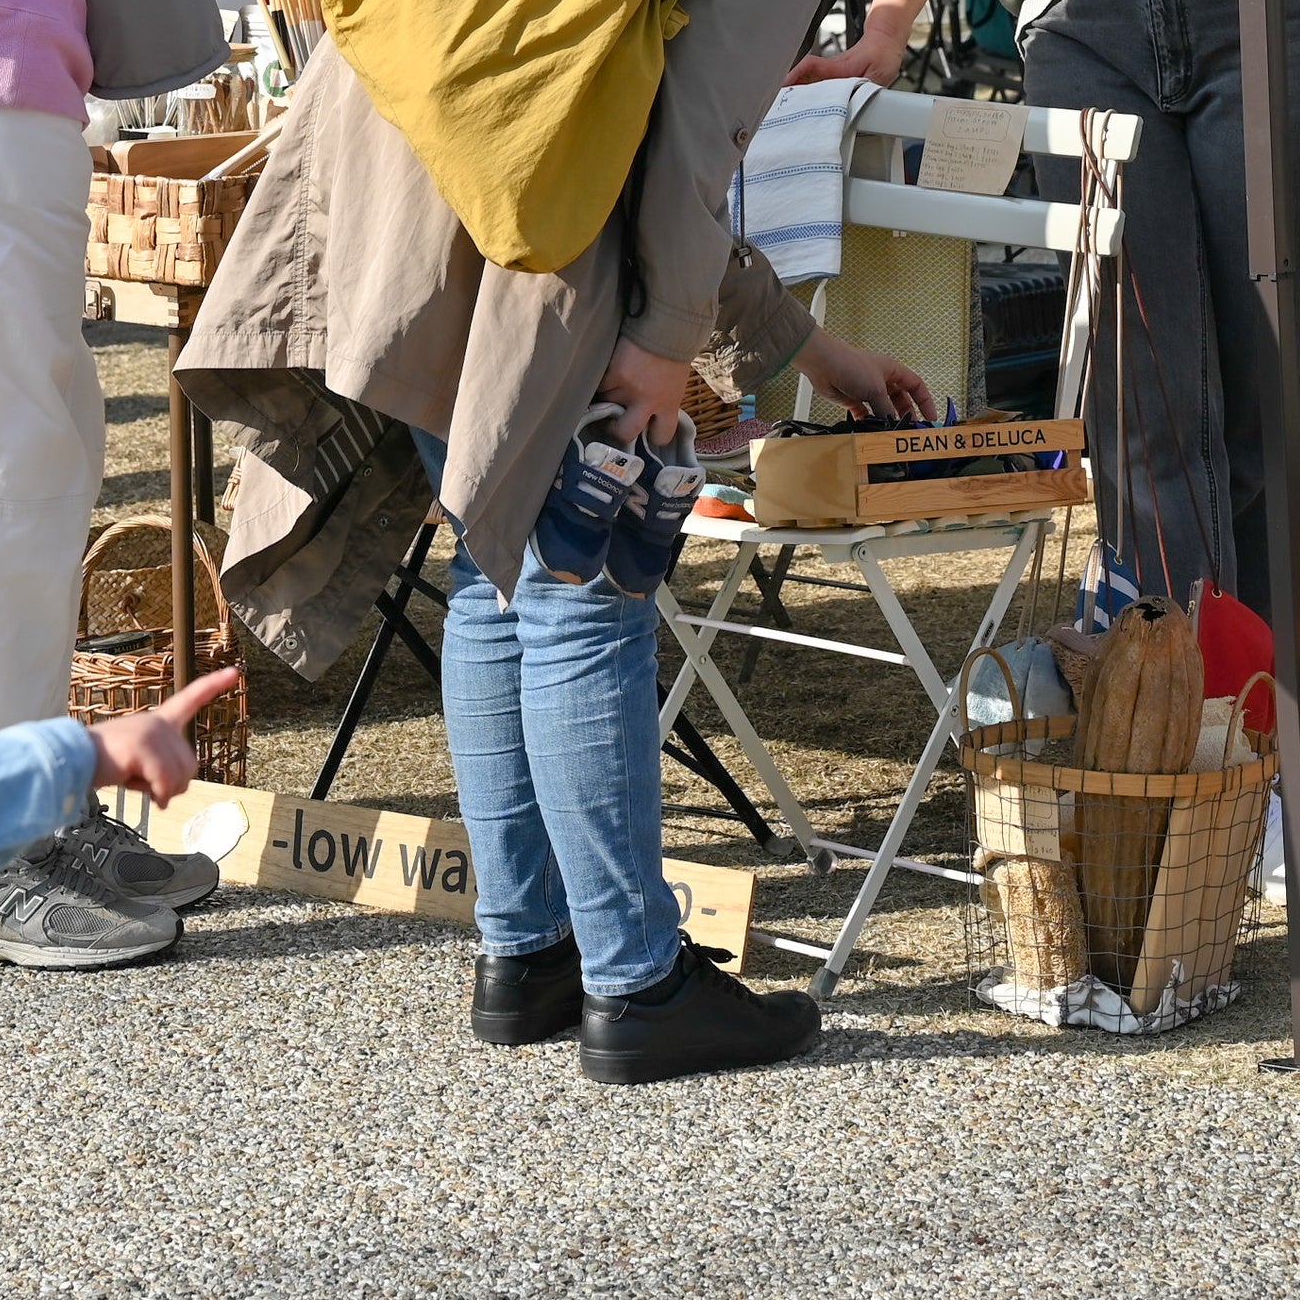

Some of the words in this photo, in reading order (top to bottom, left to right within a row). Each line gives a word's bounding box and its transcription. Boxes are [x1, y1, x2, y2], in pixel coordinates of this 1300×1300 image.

[895, 435, 948, 454] DEAN
[954, 434, 966, 449] &
[972, 429, 1046, 448] DELUCA
[272, 808, 382, 880] -low
[399, 843, 478, 895] wa
